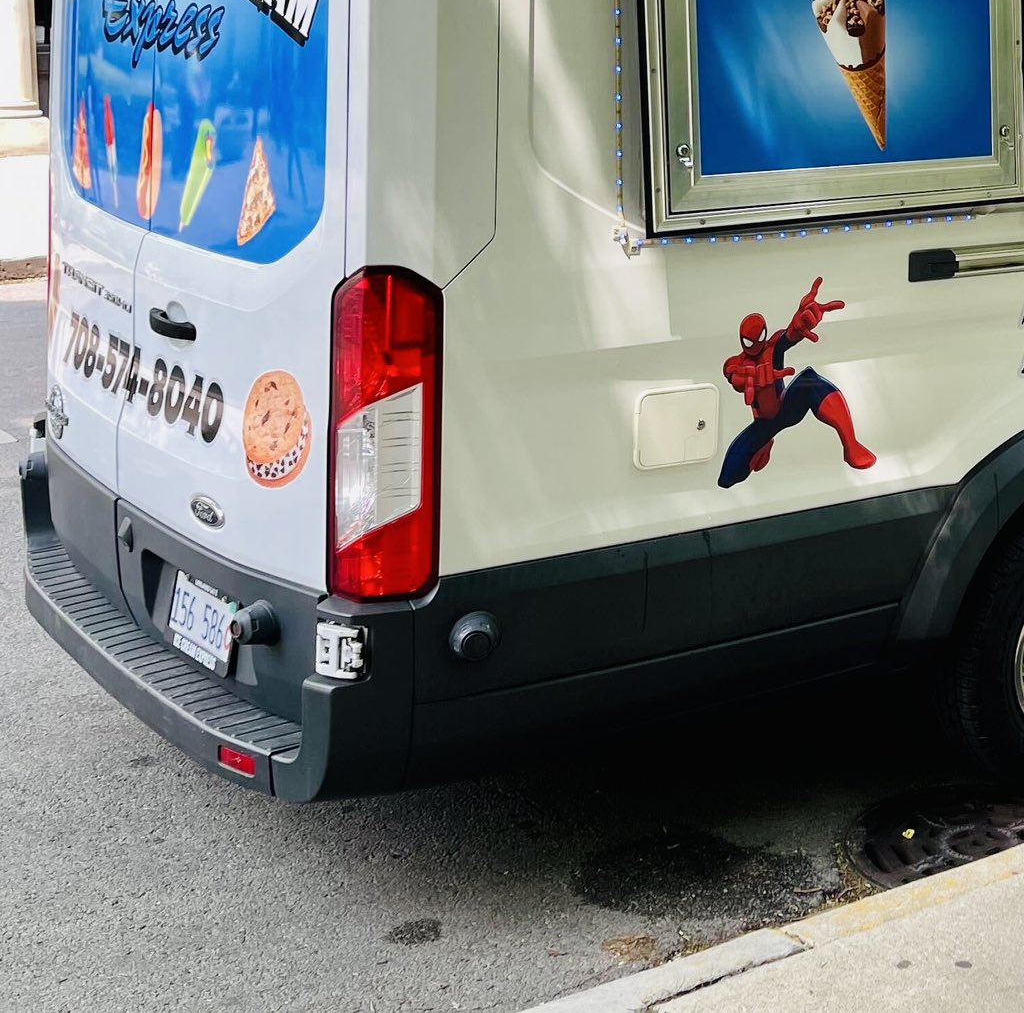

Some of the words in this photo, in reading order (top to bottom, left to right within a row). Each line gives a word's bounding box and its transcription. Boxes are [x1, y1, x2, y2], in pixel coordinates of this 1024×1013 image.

[63, 312, 225, 444] 708-574-8040
[170, 587, 196, 631] 156
[201, 603, 226, 649] 586
